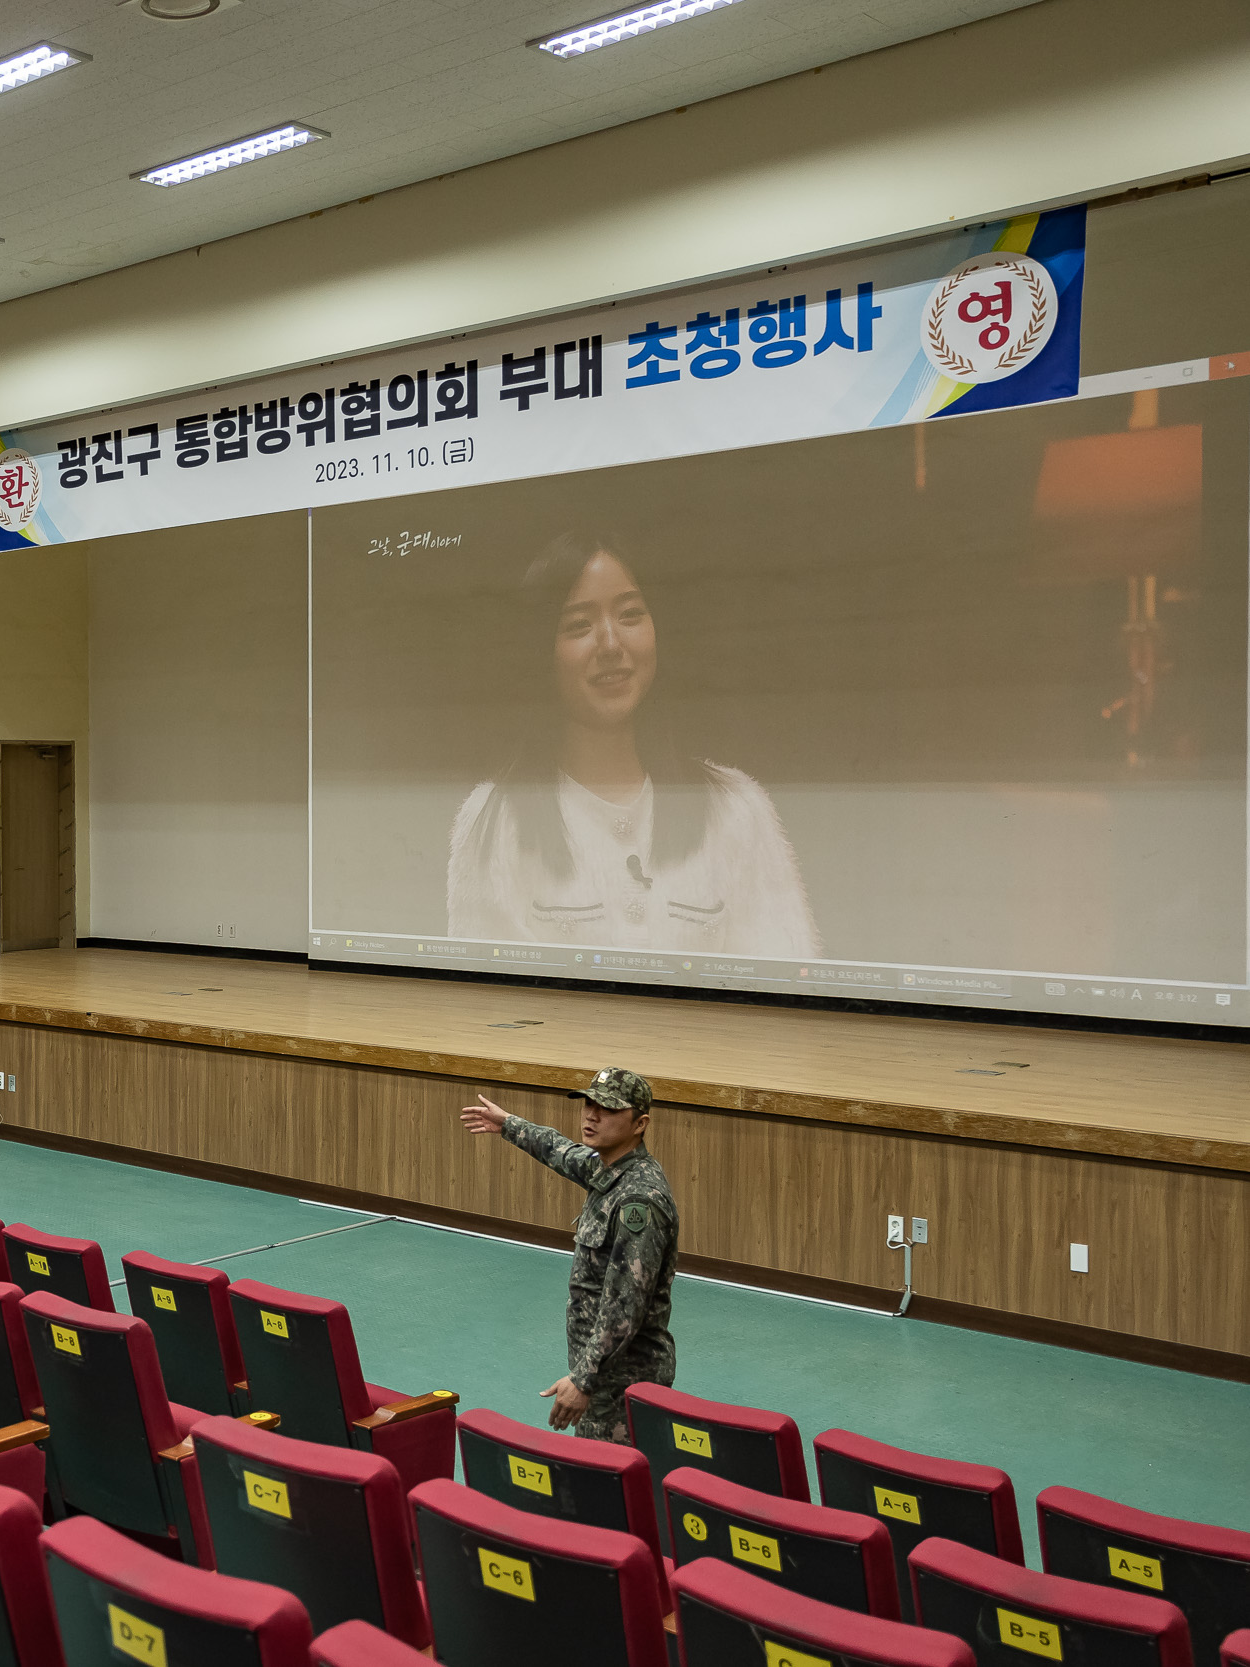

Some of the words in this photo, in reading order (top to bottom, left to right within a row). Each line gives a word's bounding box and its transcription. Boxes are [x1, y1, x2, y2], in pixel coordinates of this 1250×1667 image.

[957, 280, 1014, 351] 영
[56, 422, 162, 489] 광진구
[174, 359, 479, 469] 통합방위협의회
[499, 334, 604, 412] 부대
[625, 281, 883, 389] 초청행사
[315, 458, 364, 483] 2023.
[372, 452, 399, 474] 11.
[407, 446, 434, 468] 10.
[442, 437, 475, 466] (금)
[156, 1293, 172, 1305] A-9
[266, 1317, 283, 1330] A-8
[56, 1332, 76, 1347] B-8
[680, 1432, 704, 1448] A-7
[516, 1465, 544, 1484] B-7
[253, 1483, 281, 1504] C-7
[882, 1496, 912, 1514] A-6
[689, 1517, 702, 1537] 3
[738, 1537, 772, 1559] B-6
[488, 1562, 524, 1587] C-6
[1118, 1558, 1154, 1579] A-5
[119, 1621, 156, 1653] D-7
[1009, 1621, 1051, 1647] B-5
